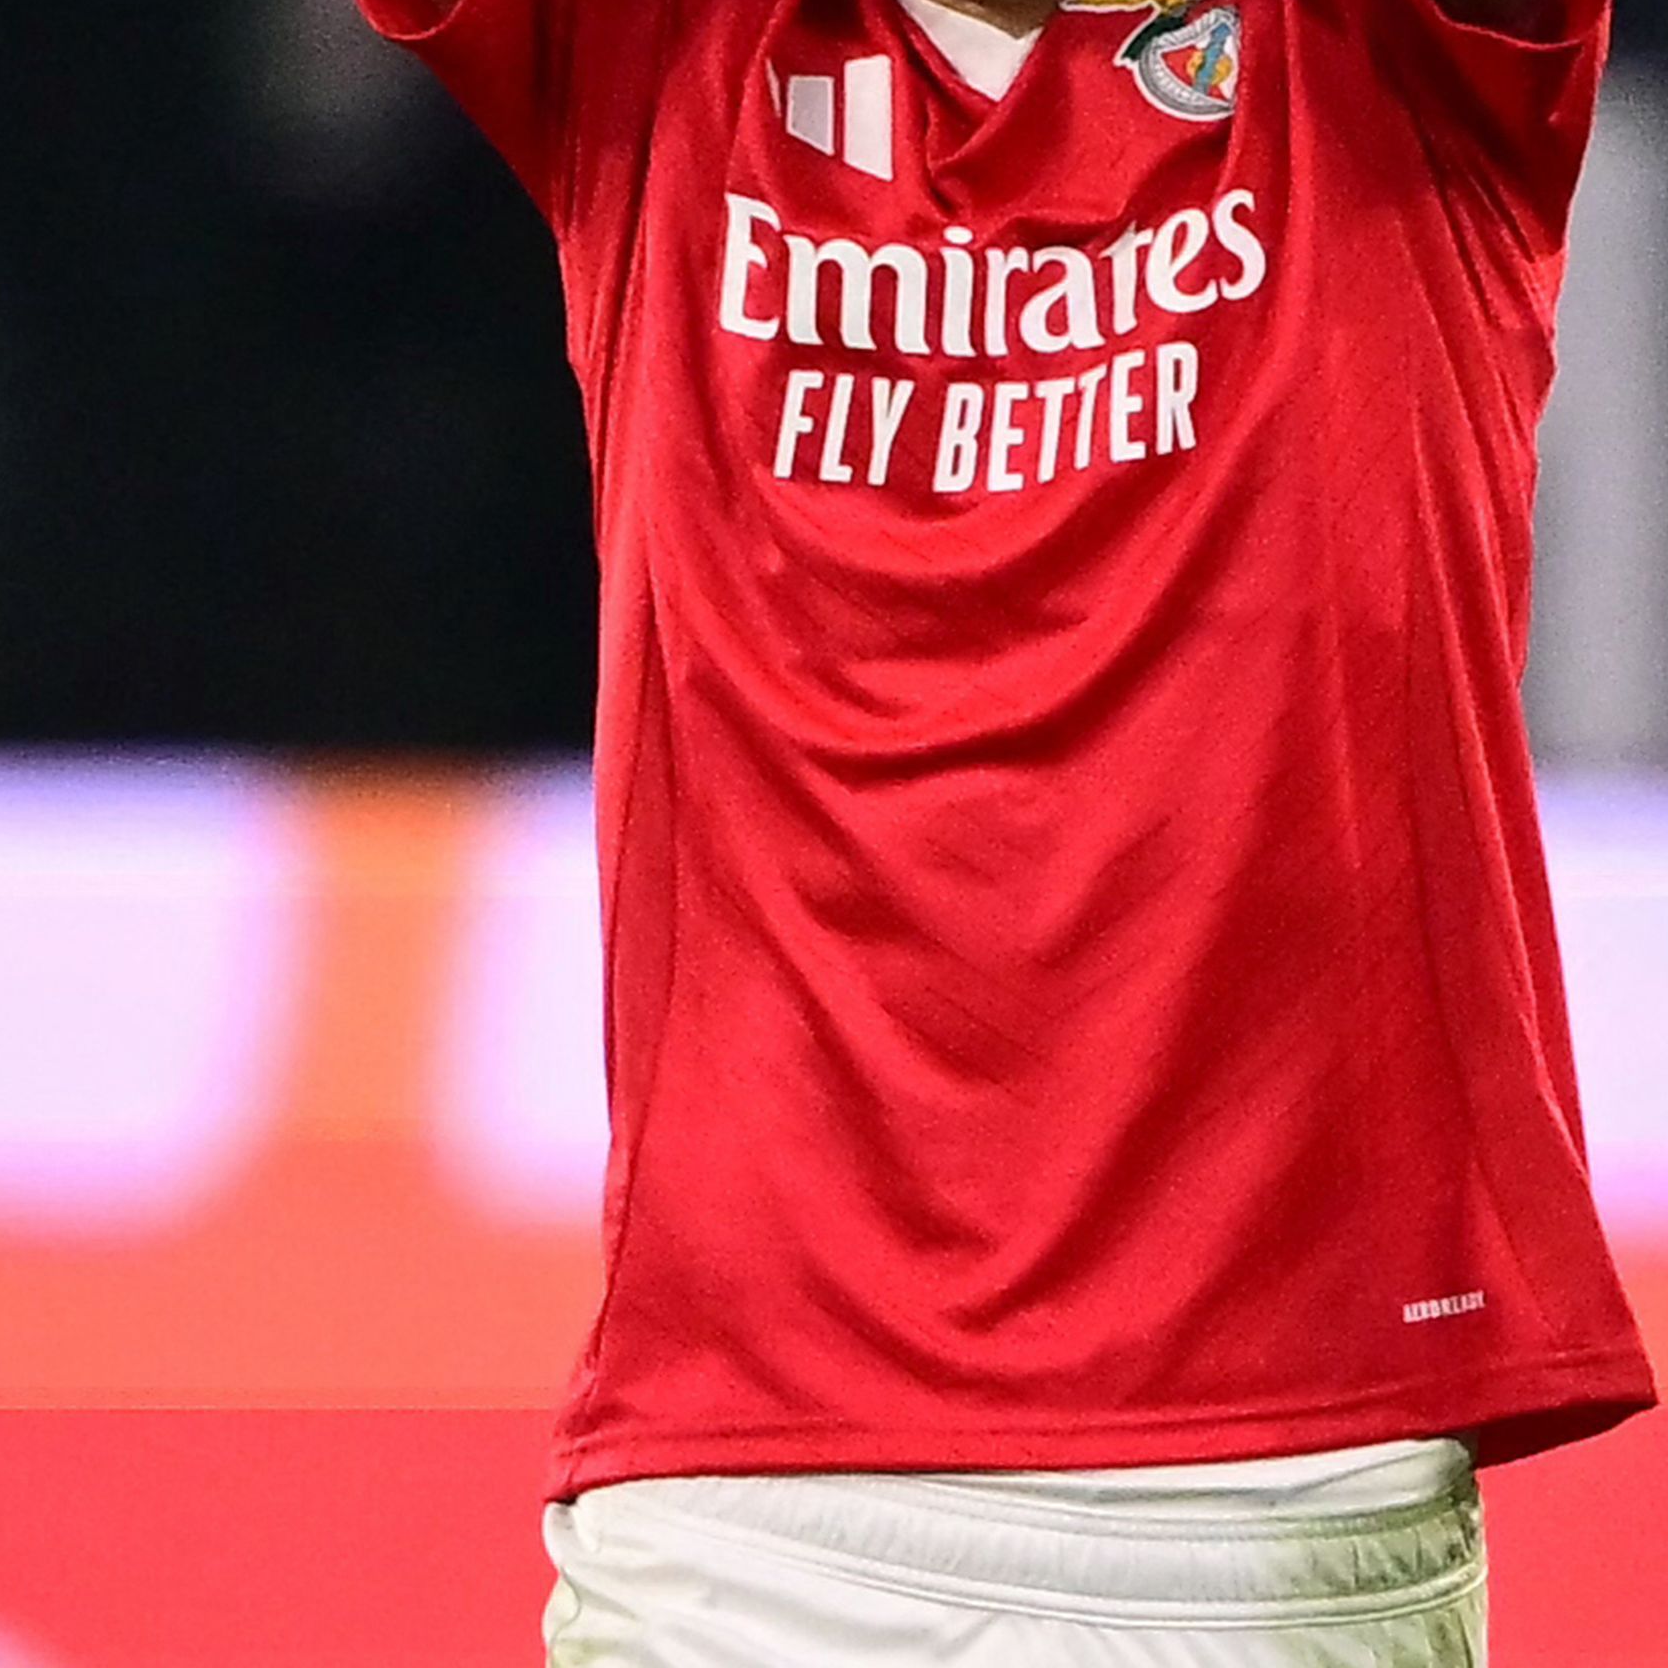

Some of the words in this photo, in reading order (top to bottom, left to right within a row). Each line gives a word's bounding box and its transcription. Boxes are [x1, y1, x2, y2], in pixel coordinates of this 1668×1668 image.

[719, 188, 1267, 358] Emirates
[773, 369, 915, 486] FLY
[932, 340, 1200, 494] BETTER
